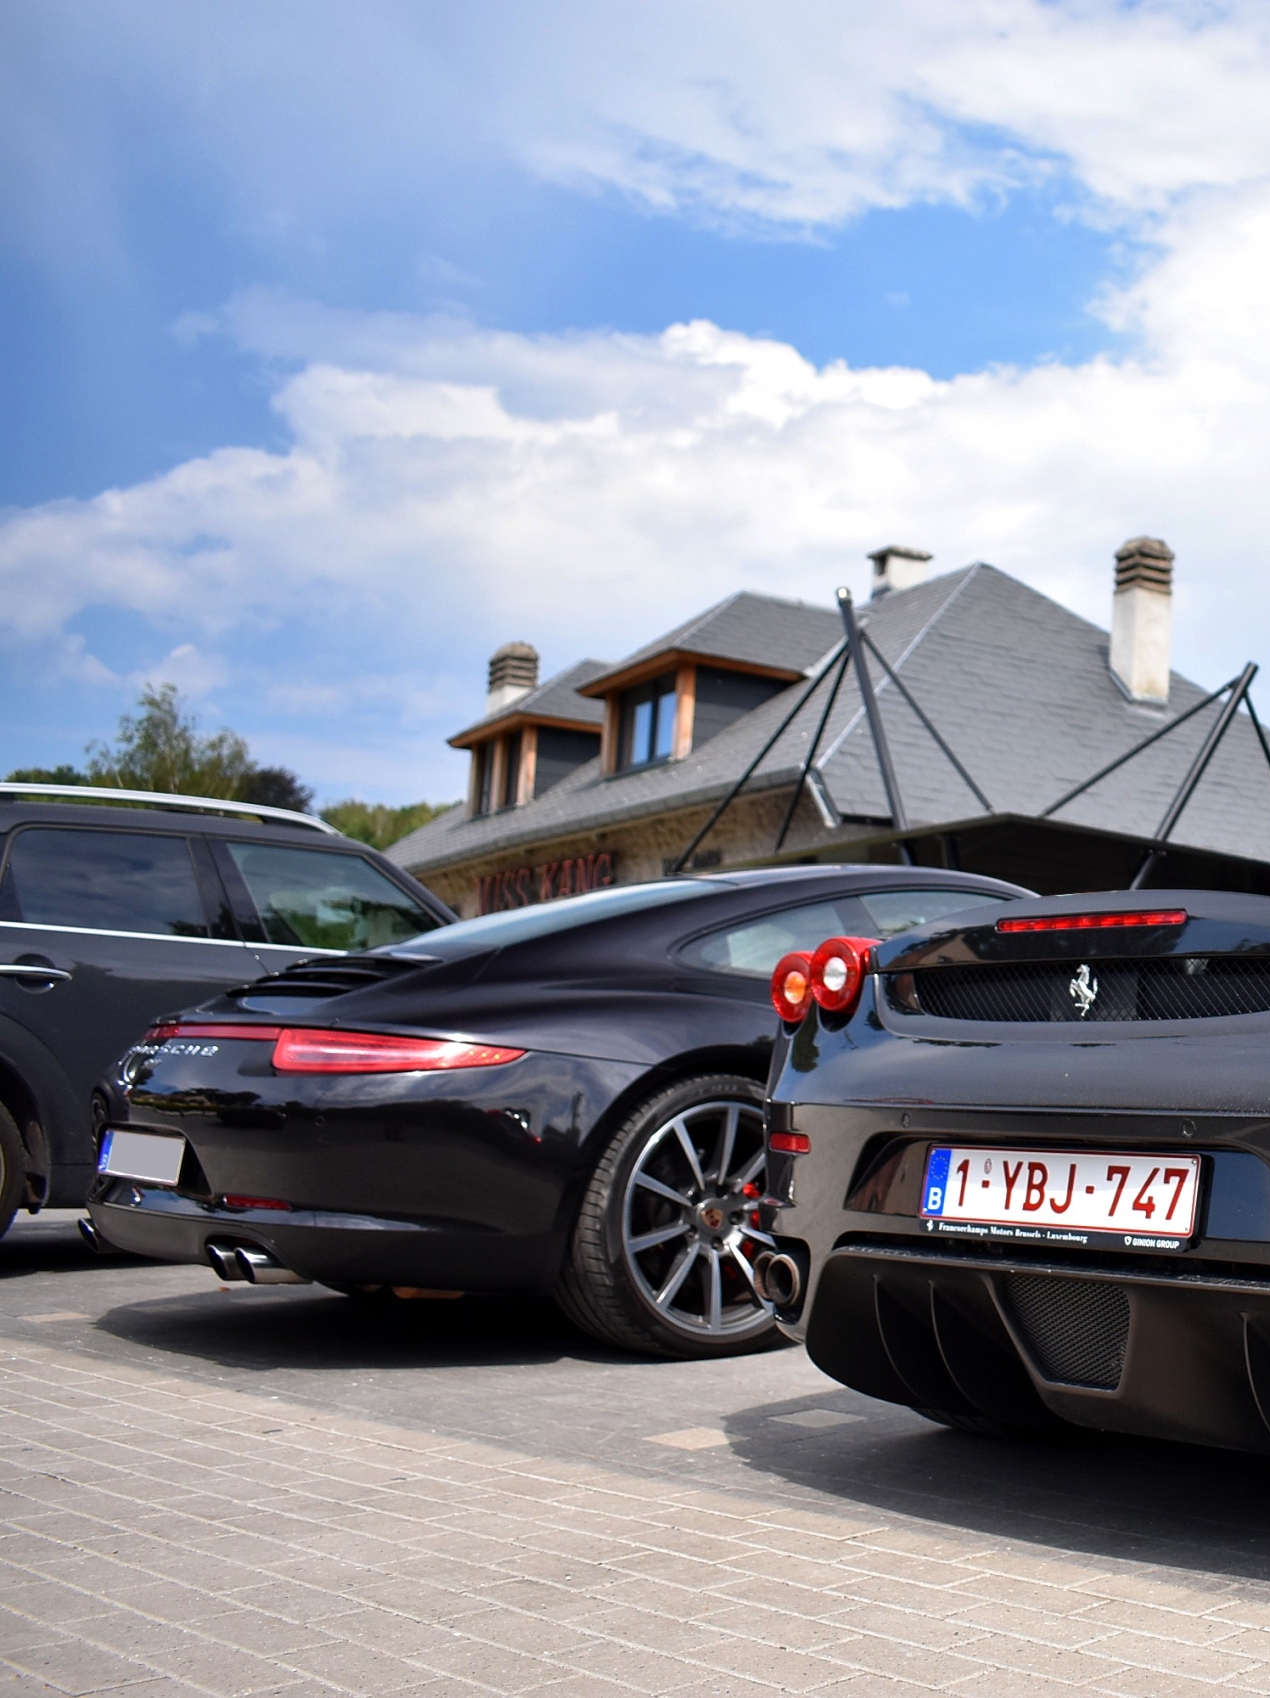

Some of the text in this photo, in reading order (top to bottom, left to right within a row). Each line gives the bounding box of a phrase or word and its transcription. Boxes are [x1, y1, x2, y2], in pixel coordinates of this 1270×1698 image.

[540, 852, 613, 901] KANG
[927, 1187, 943, 1210] B
[956, 1158, 1190, 1221] 1-YBJ-747
[990, 1226, 1014, 1237] Motors
[1015, 1229, 1041, 1238] Brussels
[1046, 1231, 1088, 1244] Luxembourg
[1156, 1239, 1180, 1249] GROUP
